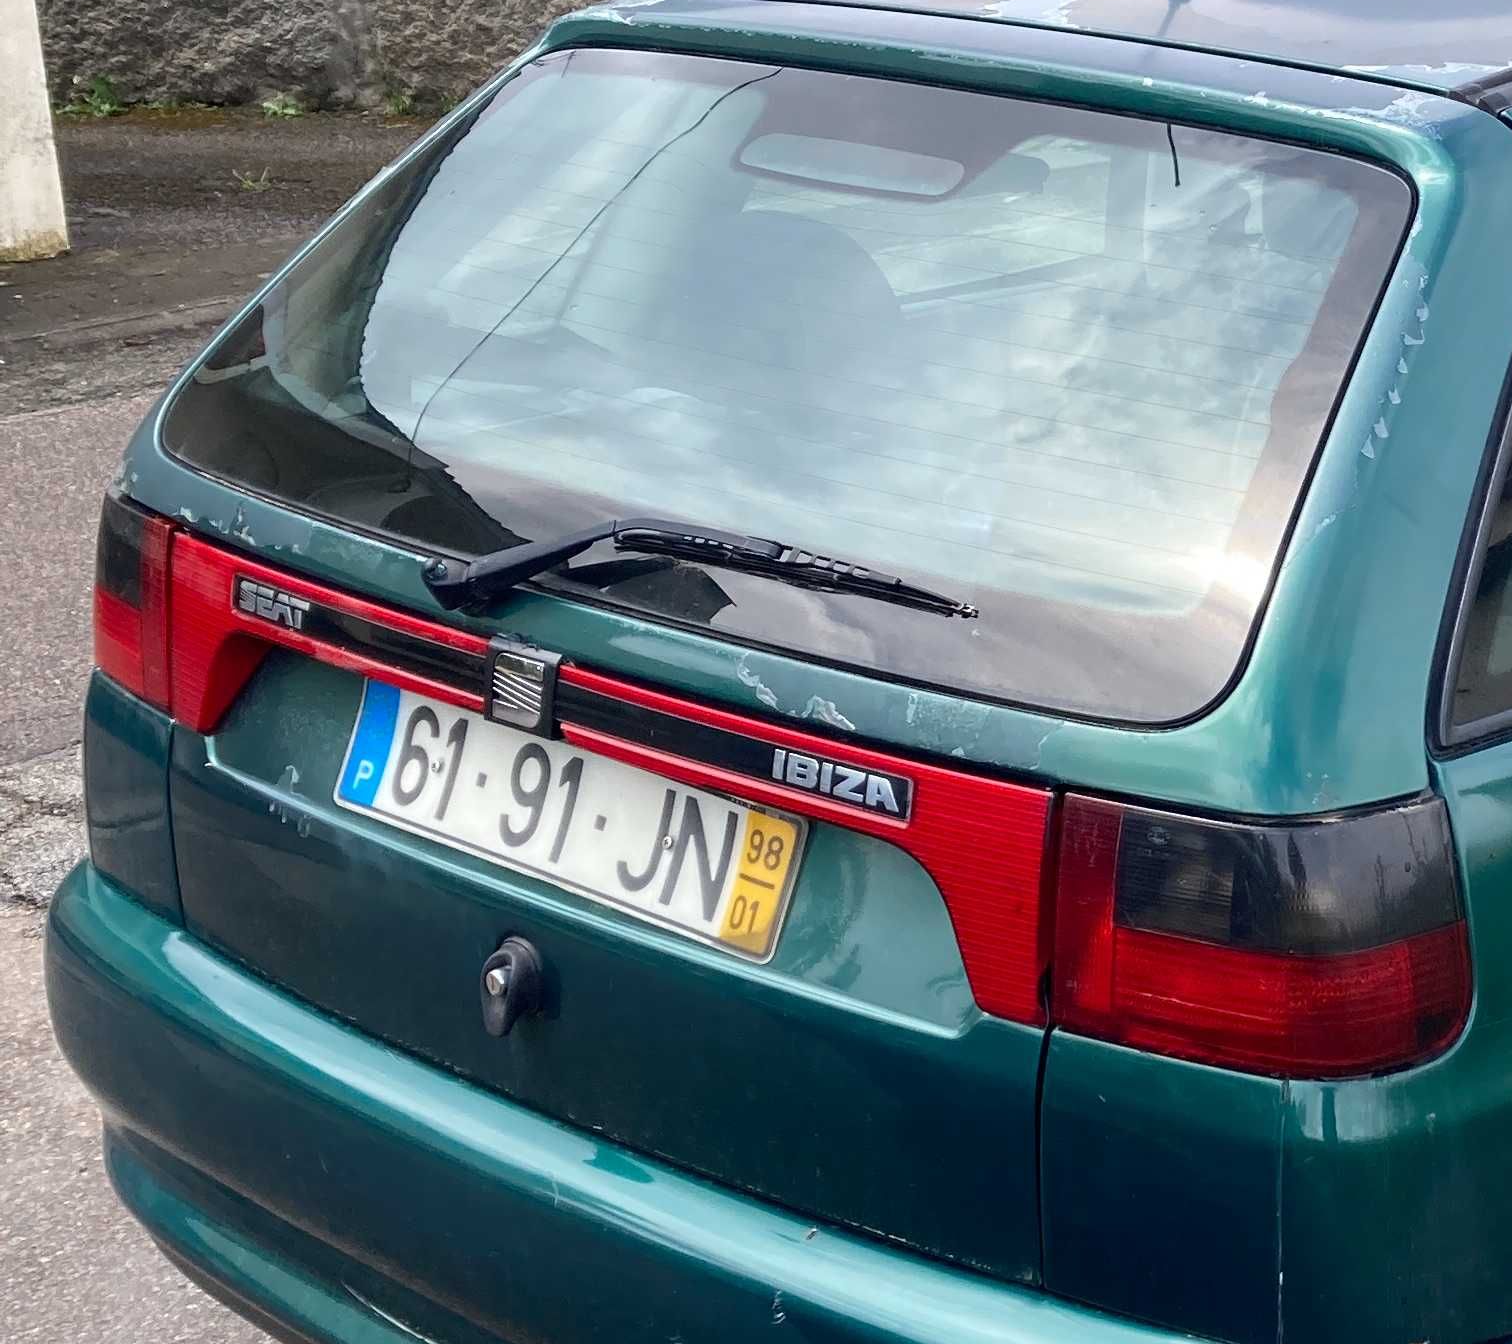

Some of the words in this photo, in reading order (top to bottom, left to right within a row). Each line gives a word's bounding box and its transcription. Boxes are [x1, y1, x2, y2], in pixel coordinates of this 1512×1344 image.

[238, 579, 311, 630] SEAT
[352, 759, 375, 790] P
[771, 748, 900, 813] IBIZA
[746, 828, 785, 871] 98
[729, 894, 761, 934] 01
